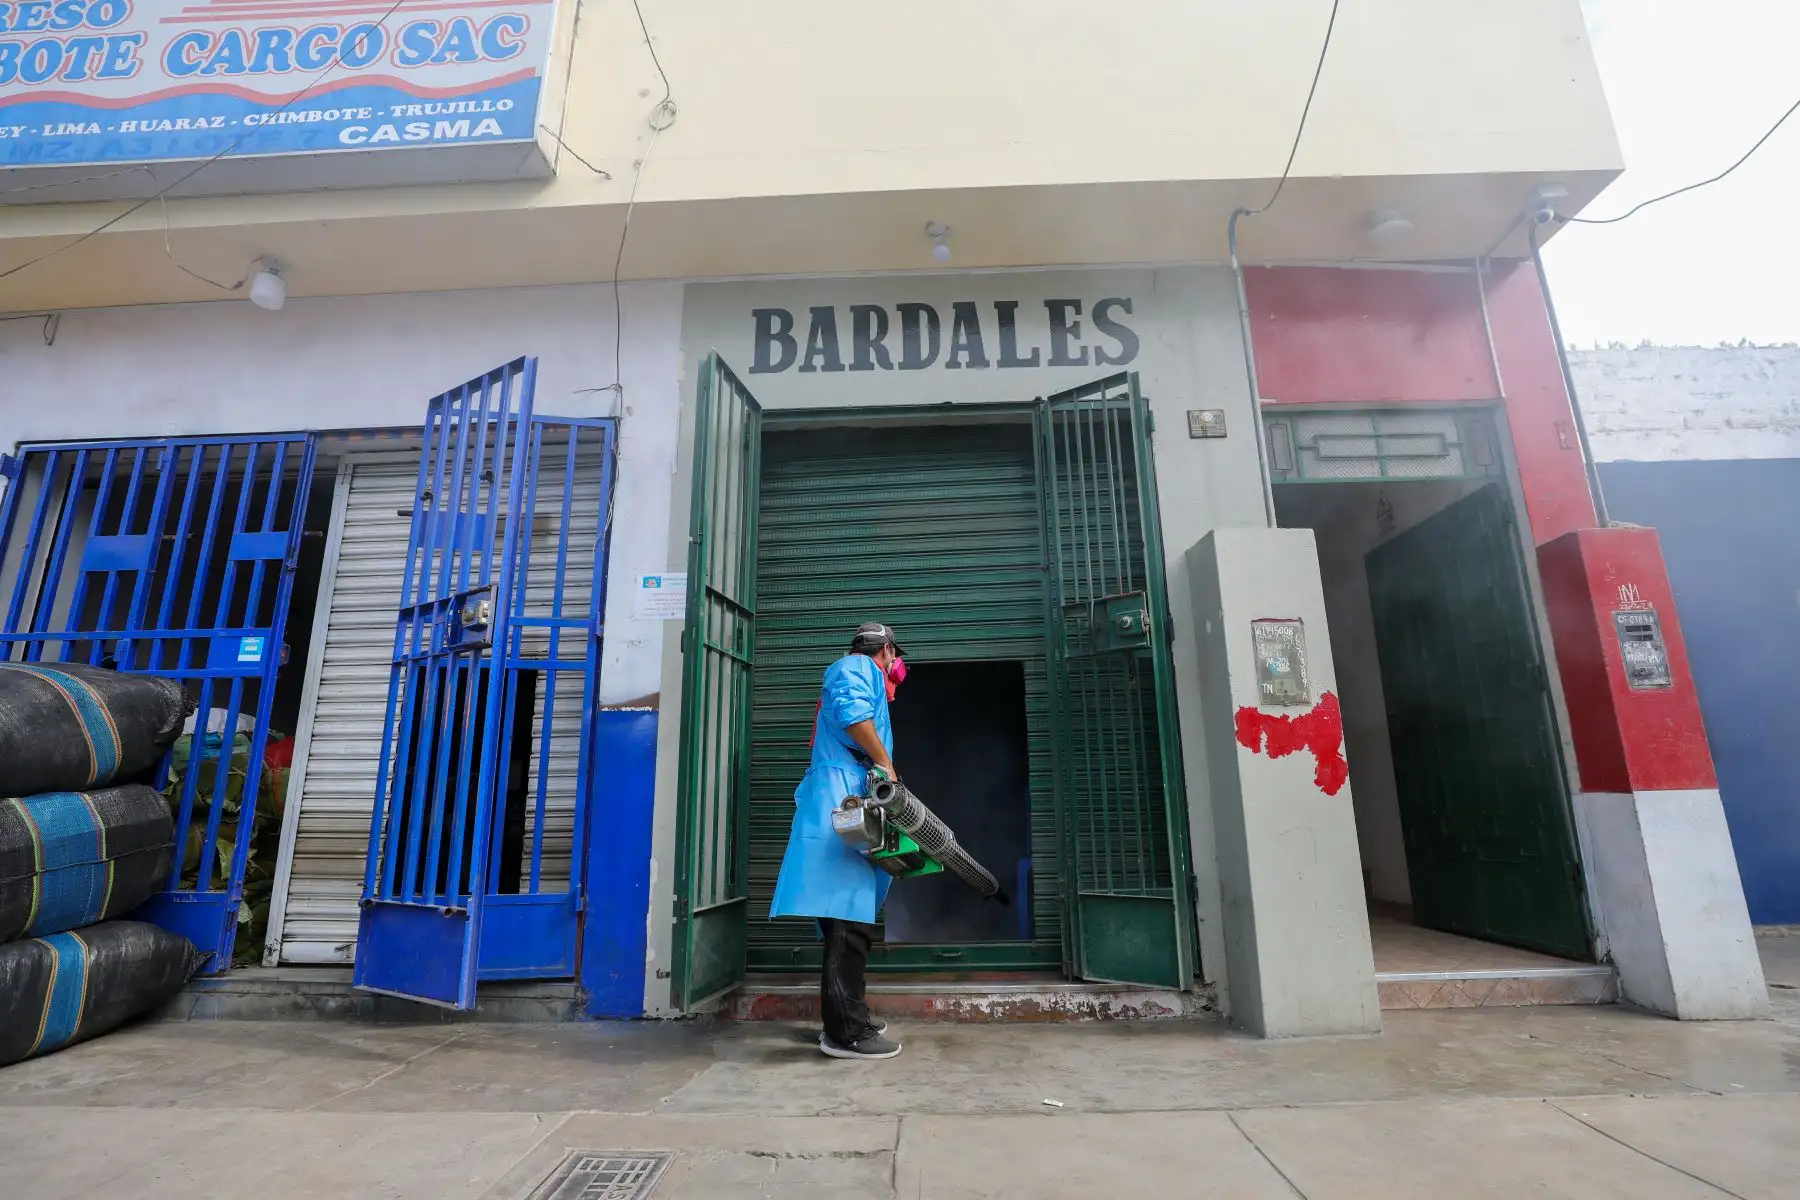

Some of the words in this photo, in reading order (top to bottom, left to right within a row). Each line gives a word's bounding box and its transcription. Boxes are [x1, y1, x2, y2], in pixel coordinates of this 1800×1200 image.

[163, 22, 387, 77] CARGO
[393, 14, 528, 67] SAC
[42, 122, 101, 136] LIMA
[119, 116, 226, 134] HUARAZ
[244, 107, 372, 126] CHIMBOTE
[391, 99, 514, 117] TRUJILLO
[339, 118, 503, 144] CASMA
[748, 297, 1140, 373] BARDALES
[1262, 683, 1274, 694] TN
